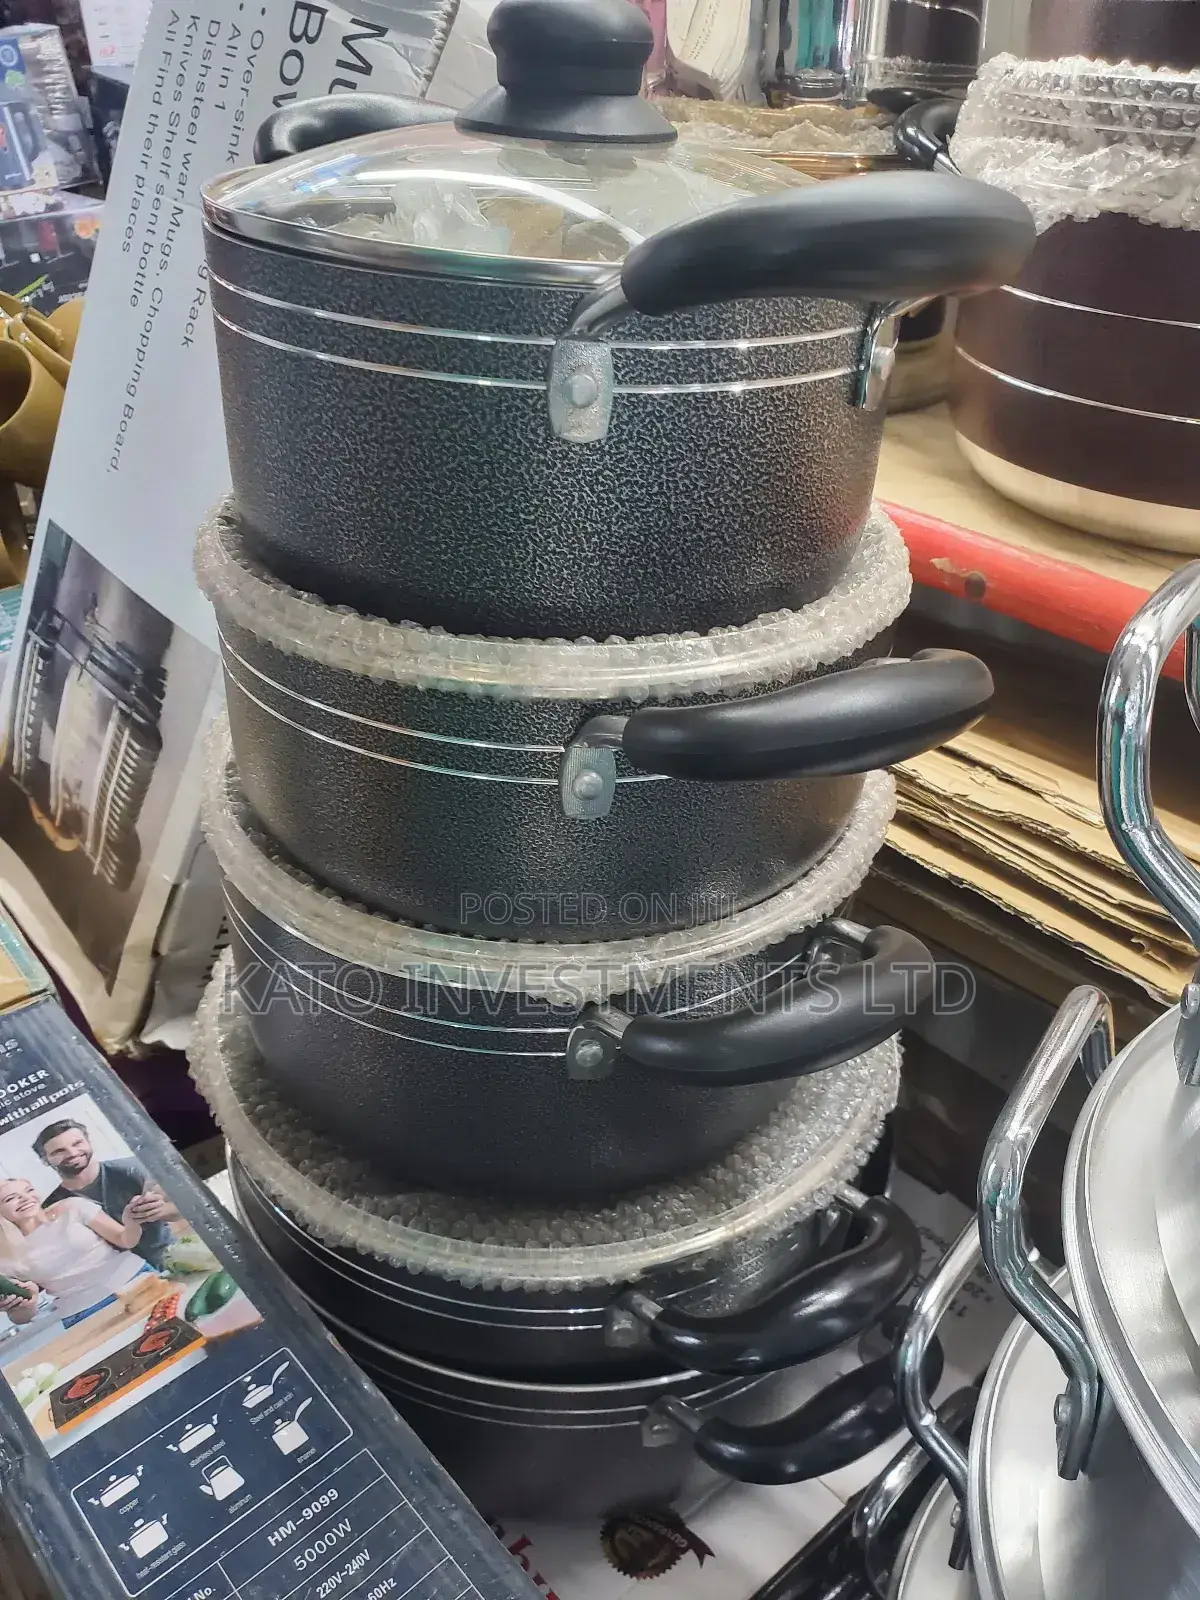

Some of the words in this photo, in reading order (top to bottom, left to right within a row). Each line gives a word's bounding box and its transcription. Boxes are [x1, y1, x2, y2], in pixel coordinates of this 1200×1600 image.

[164, 9, 180, 42] All
[224, 22, 242, 58] All
[152, 50, 173, 106] Find
[172, 14, 201, 102] Knives
[185, 19, 222, 145] Dishsteel
[218, 66, 234, 89] in
[214, 100, 226, 111] 1
[225, 29, 265, 164] Over-sink
[140, 113, 160, 170] their
[159, 110, 180, 180] Shelf
[122, 173, 146, 253] places
[145, 182, 165, 236] sent
[129, 241, 154, 308] bottle
[126, 286, 164, 398] Chopping
[181, 287, 207, 349] Rack
[118, 1497, 140, 1515] copper
[267, 1488, 339, 1547] HM-9099
[294, 1517, 353, 1571] 5000W
[367, 1577, 397, 1600] 60Hz
